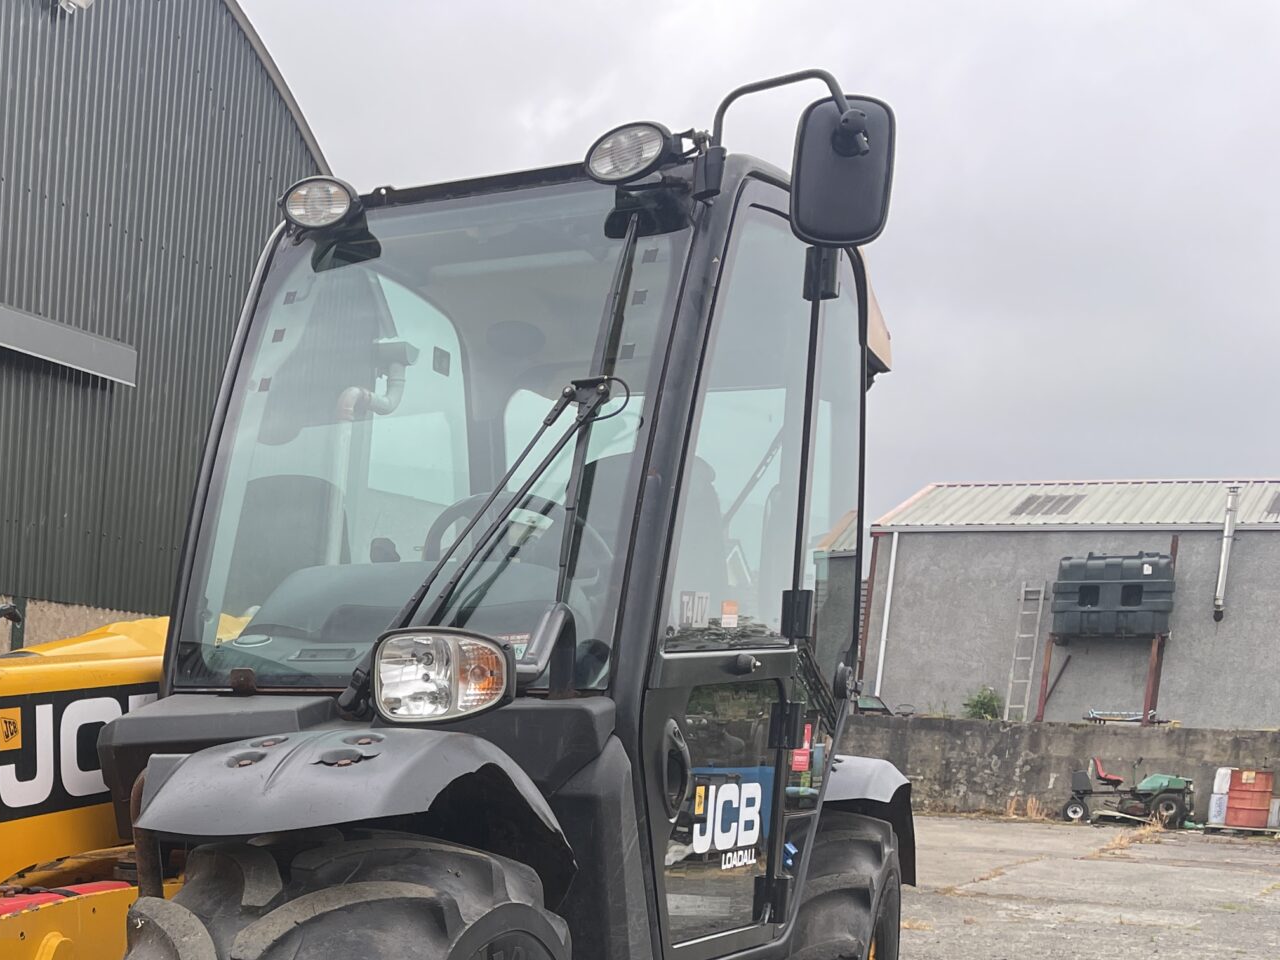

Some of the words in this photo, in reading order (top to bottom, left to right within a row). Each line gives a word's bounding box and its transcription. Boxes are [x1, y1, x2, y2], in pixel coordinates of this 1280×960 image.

[4, 719, 18, 740] JCB
[692, 783, 761, 854] JCB
[721, 848, 756, 870] LOADALL
